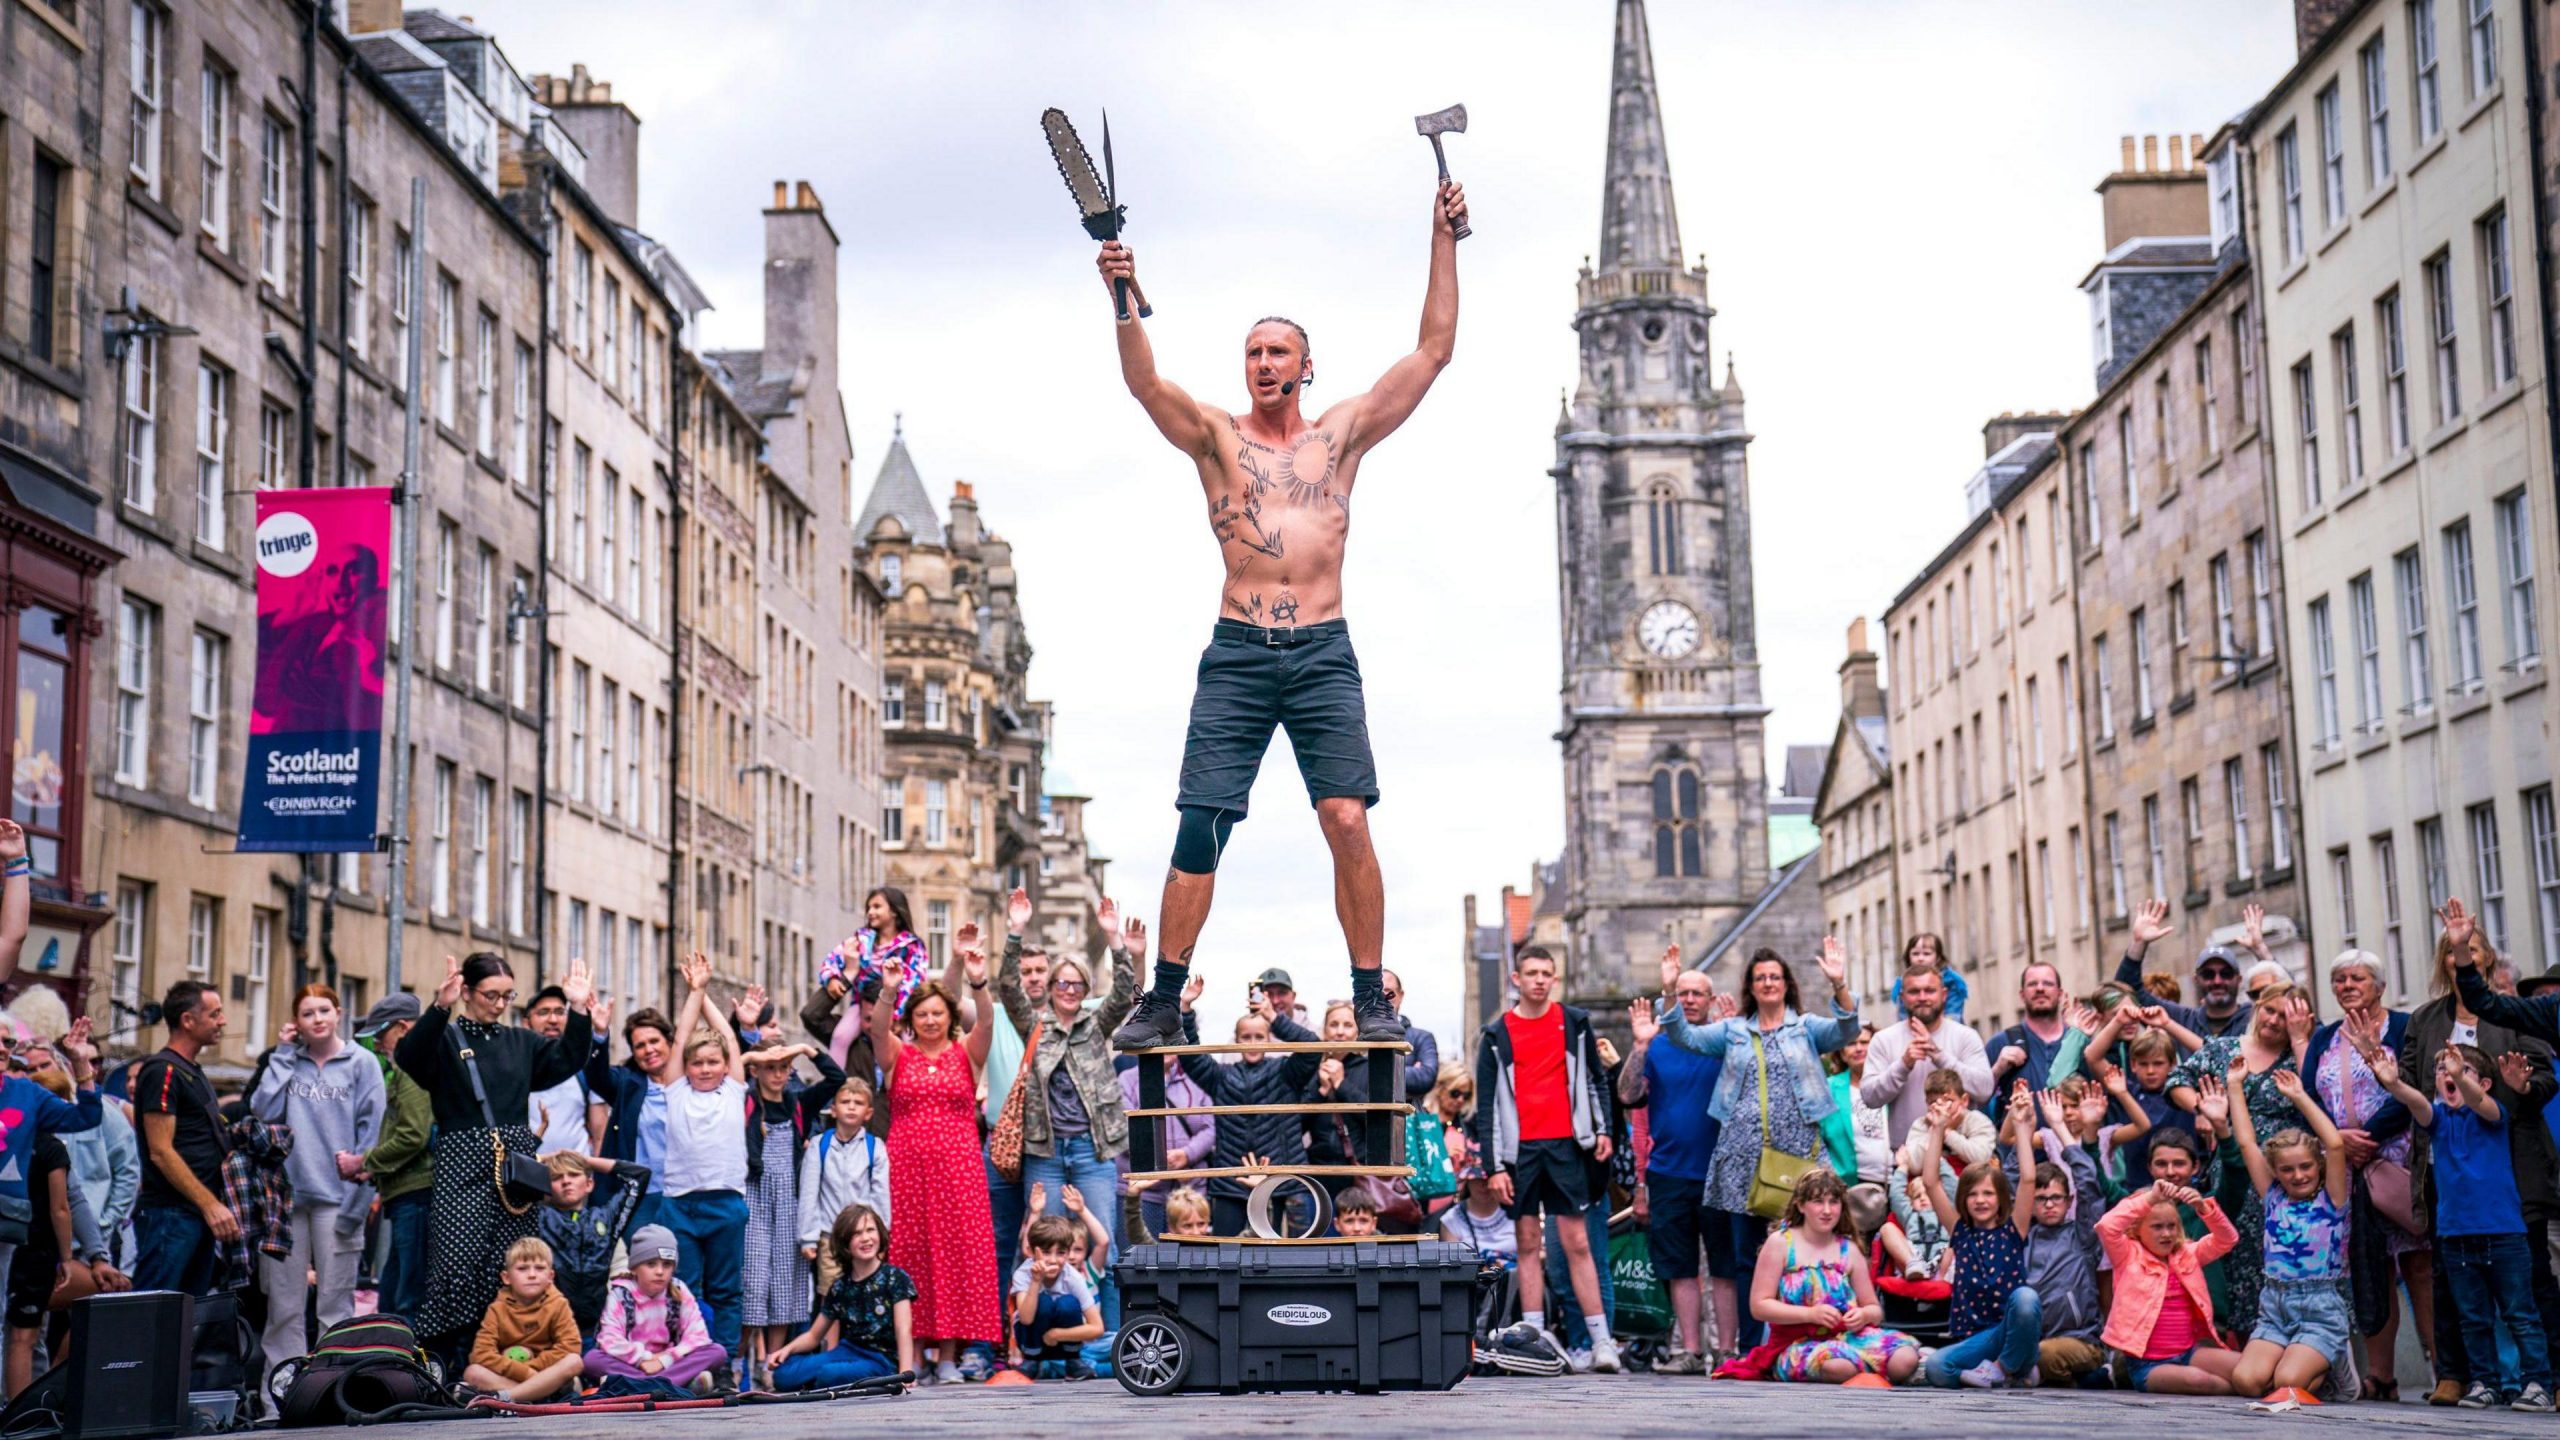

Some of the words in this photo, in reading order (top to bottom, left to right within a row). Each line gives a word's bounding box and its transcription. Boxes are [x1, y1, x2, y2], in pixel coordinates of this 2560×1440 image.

[259, 531, 312, 557] fringe
[267, 746, 360, 773] Scotland
[266, 773, 286, 785] The
[287, 772, 325, 784] Perfect
[326, 772, 358, 786] Stage
[1271, 1310, 1327, 1319] REIDICULOUS
[107, 1361, 137, 1370] BOSE
